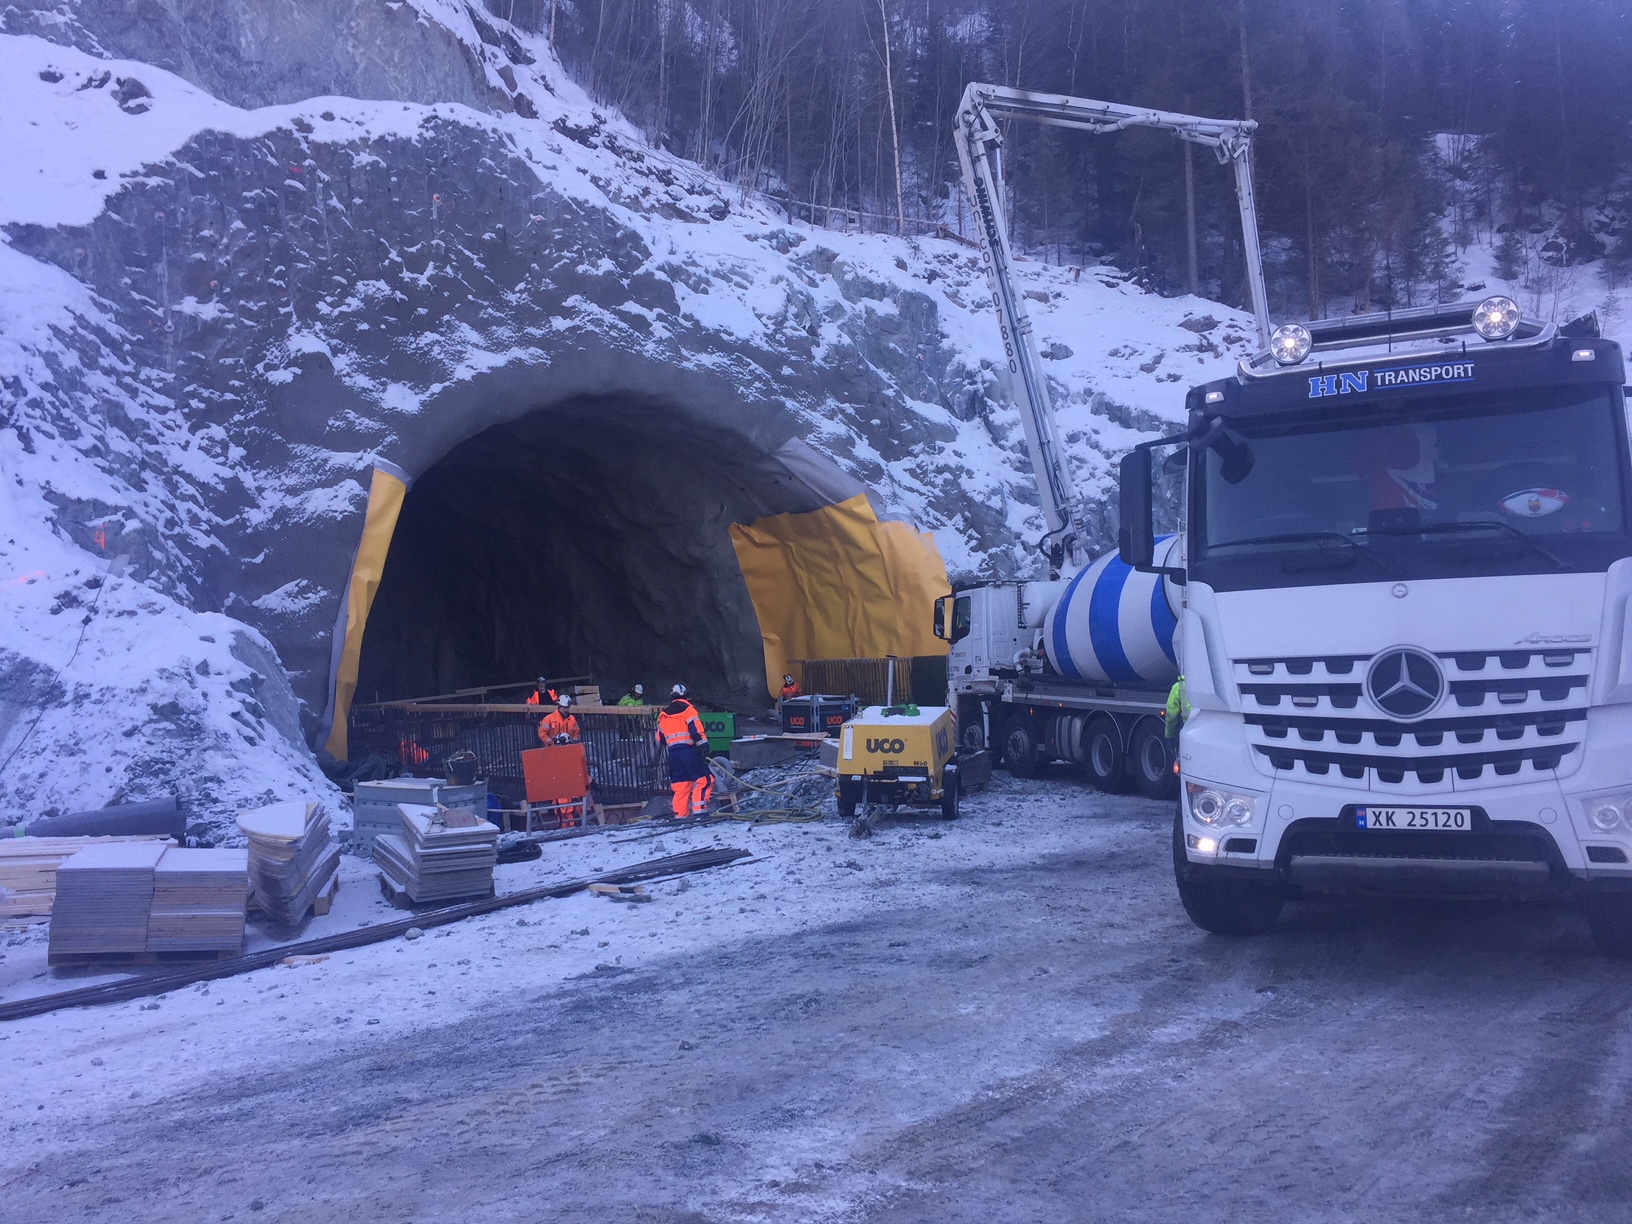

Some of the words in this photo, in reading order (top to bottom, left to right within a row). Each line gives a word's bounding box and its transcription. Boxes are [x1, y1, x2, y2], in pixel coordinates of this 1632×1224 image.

[973, 176, 999, 248] SCHWING
[992, 291, 1017, 374] 07880
[1308, 370, 1368, 398] HN
[1374, 364, 1475, 385] TRANSPORT
[789, 716, 805, 726] UCO
[827, 715, 843, 725] UCO
[866, 738, 905, 754] UCO
[1372, 810, 1397, 827] XK
[1406, 811, 1465, 828] 25120
